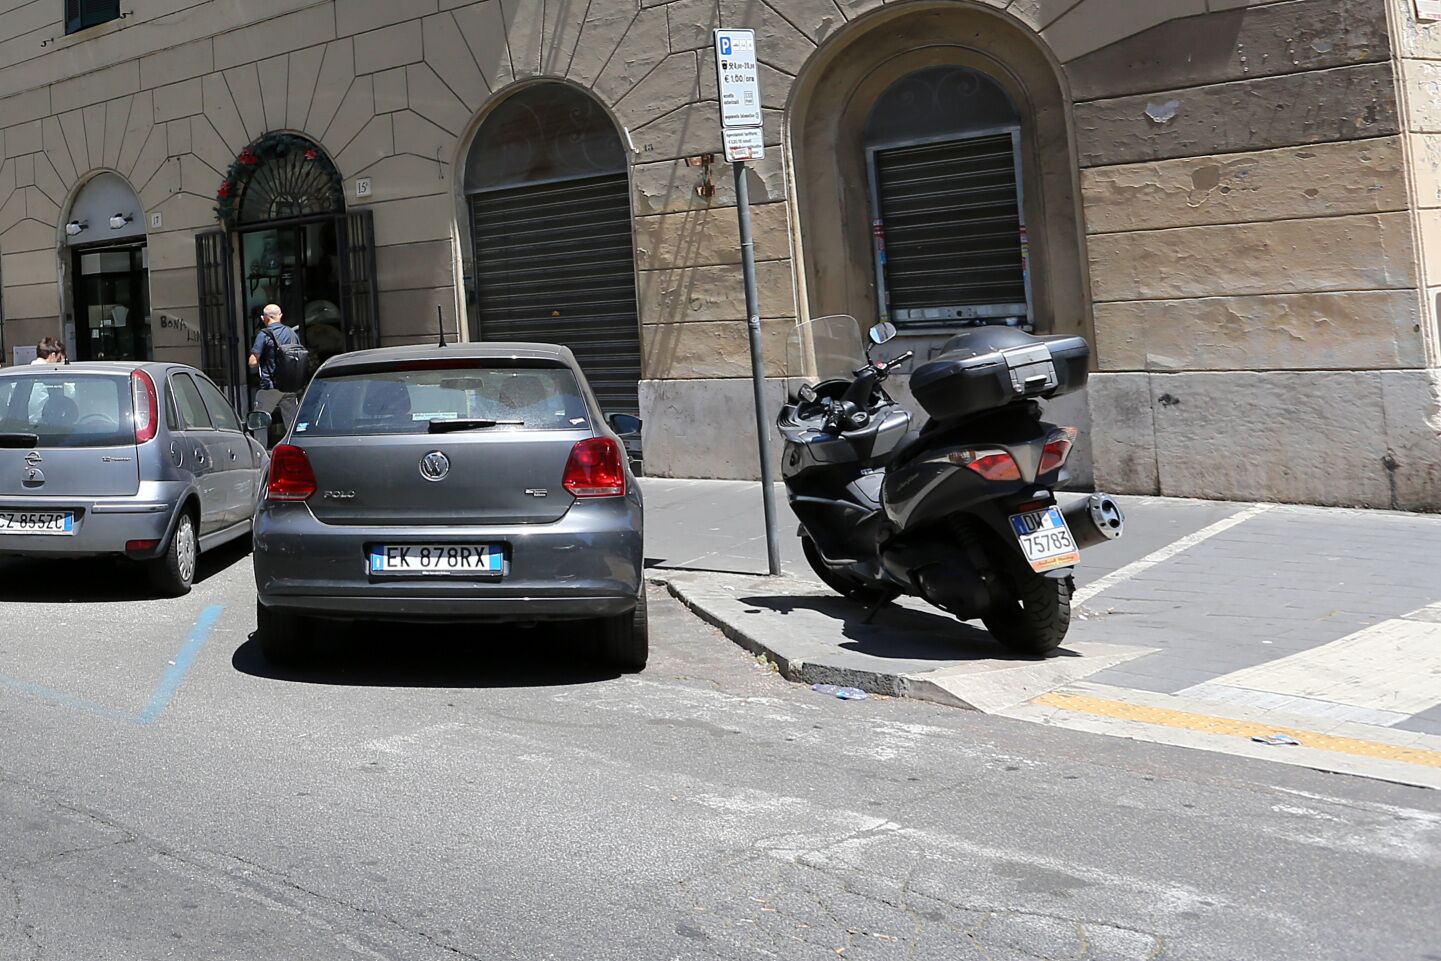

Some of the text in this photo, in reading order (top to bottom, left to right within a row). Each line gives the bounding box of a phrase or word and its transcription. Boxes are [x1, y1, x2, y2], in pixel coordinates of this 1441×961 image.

[721, 38, 730, 54] P
[324, 490, 355, 498] POLO
[20, 514, 63, 529] 855ZC
[1023, 530, 1071, 556] 75783
[387, 547, 486, 568] EK 878RX
